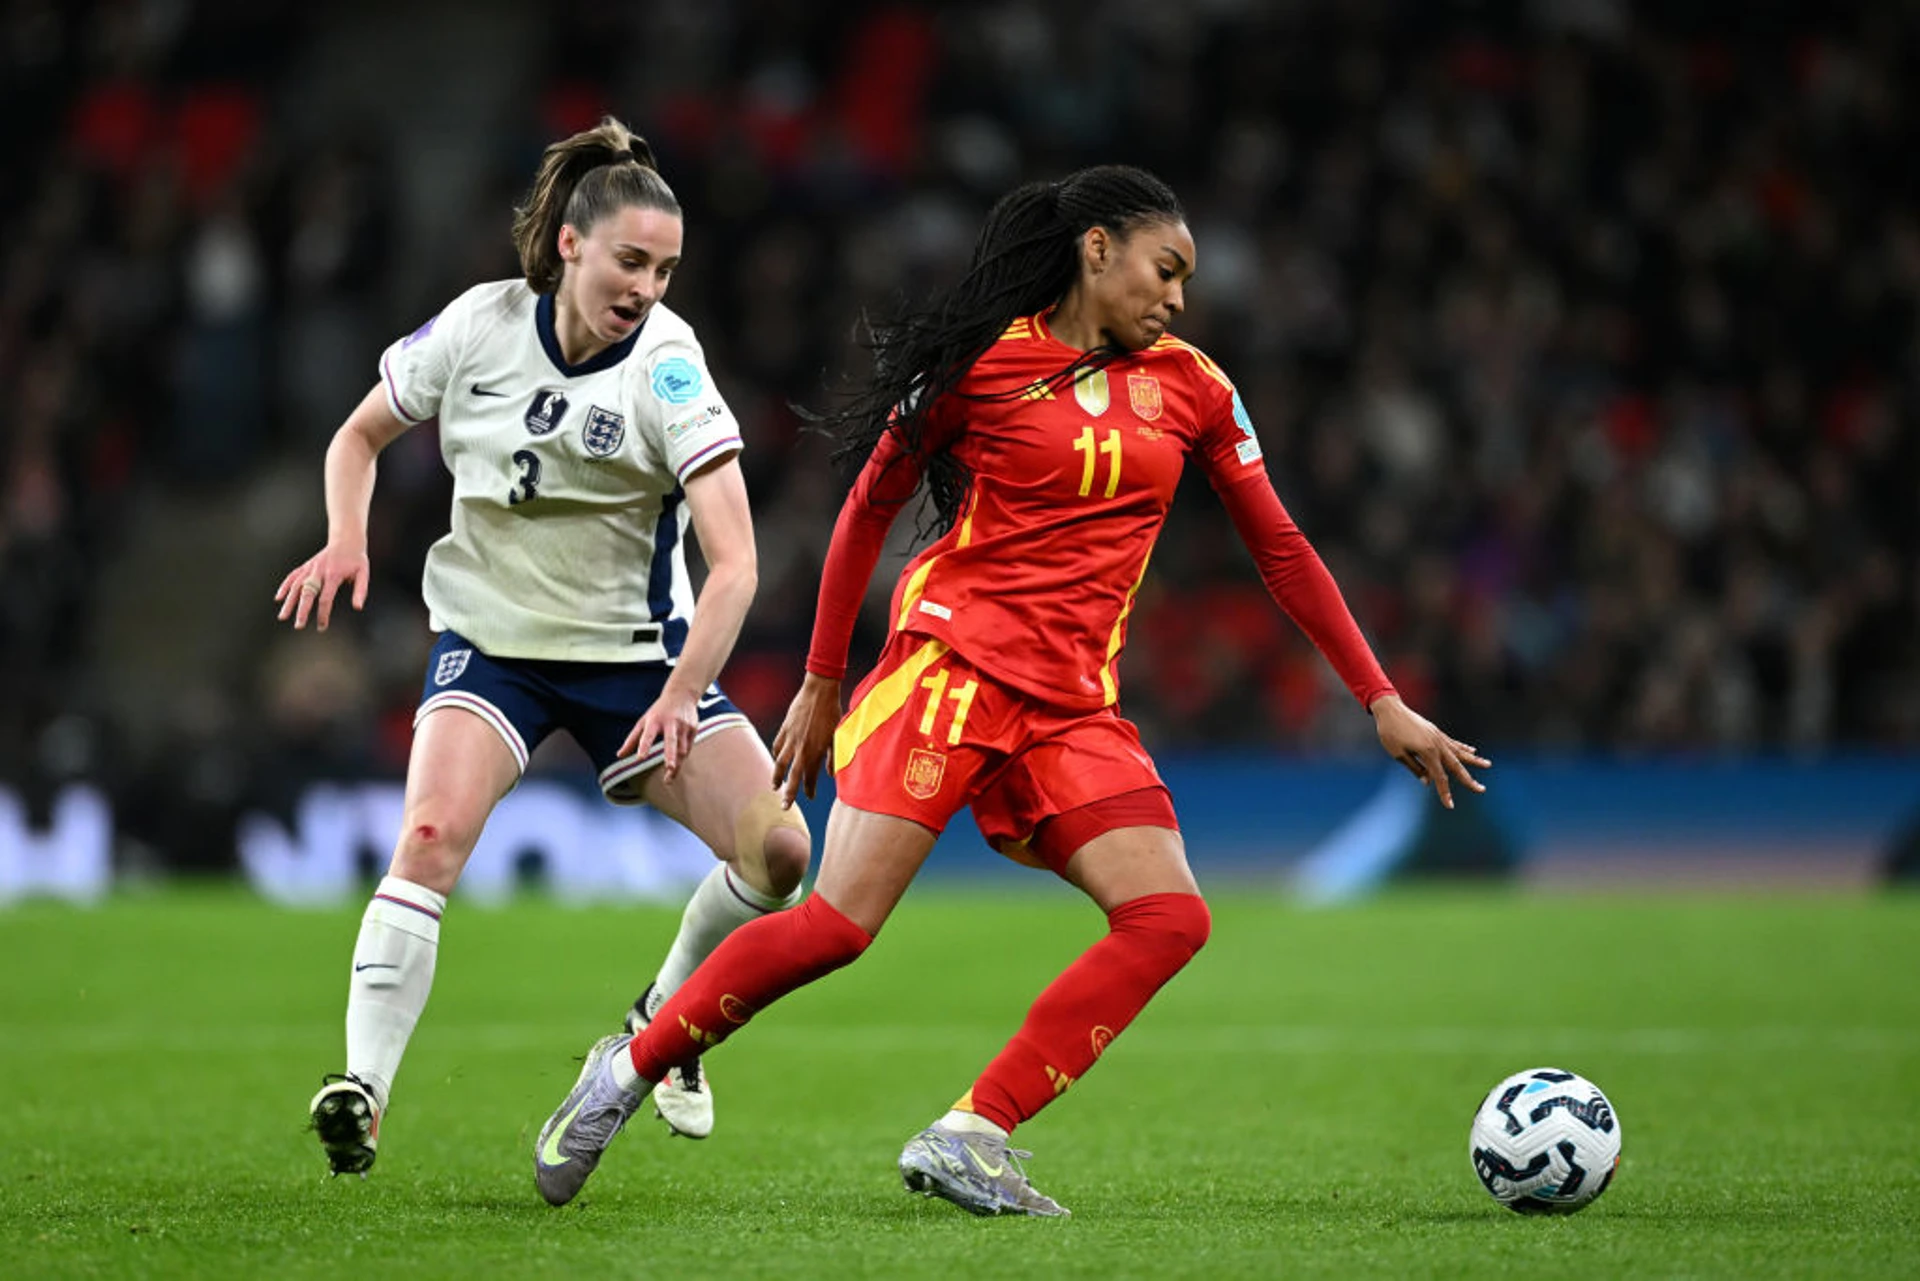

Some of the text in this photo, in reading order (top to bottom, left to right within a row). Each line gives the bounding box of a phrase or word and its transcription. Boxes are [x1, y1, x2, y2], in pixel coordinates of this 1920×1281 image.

[508, 449, 543, 505] 3
[1073, 426, 1123, 498] 11
[919, 668, 979, 745] 11
